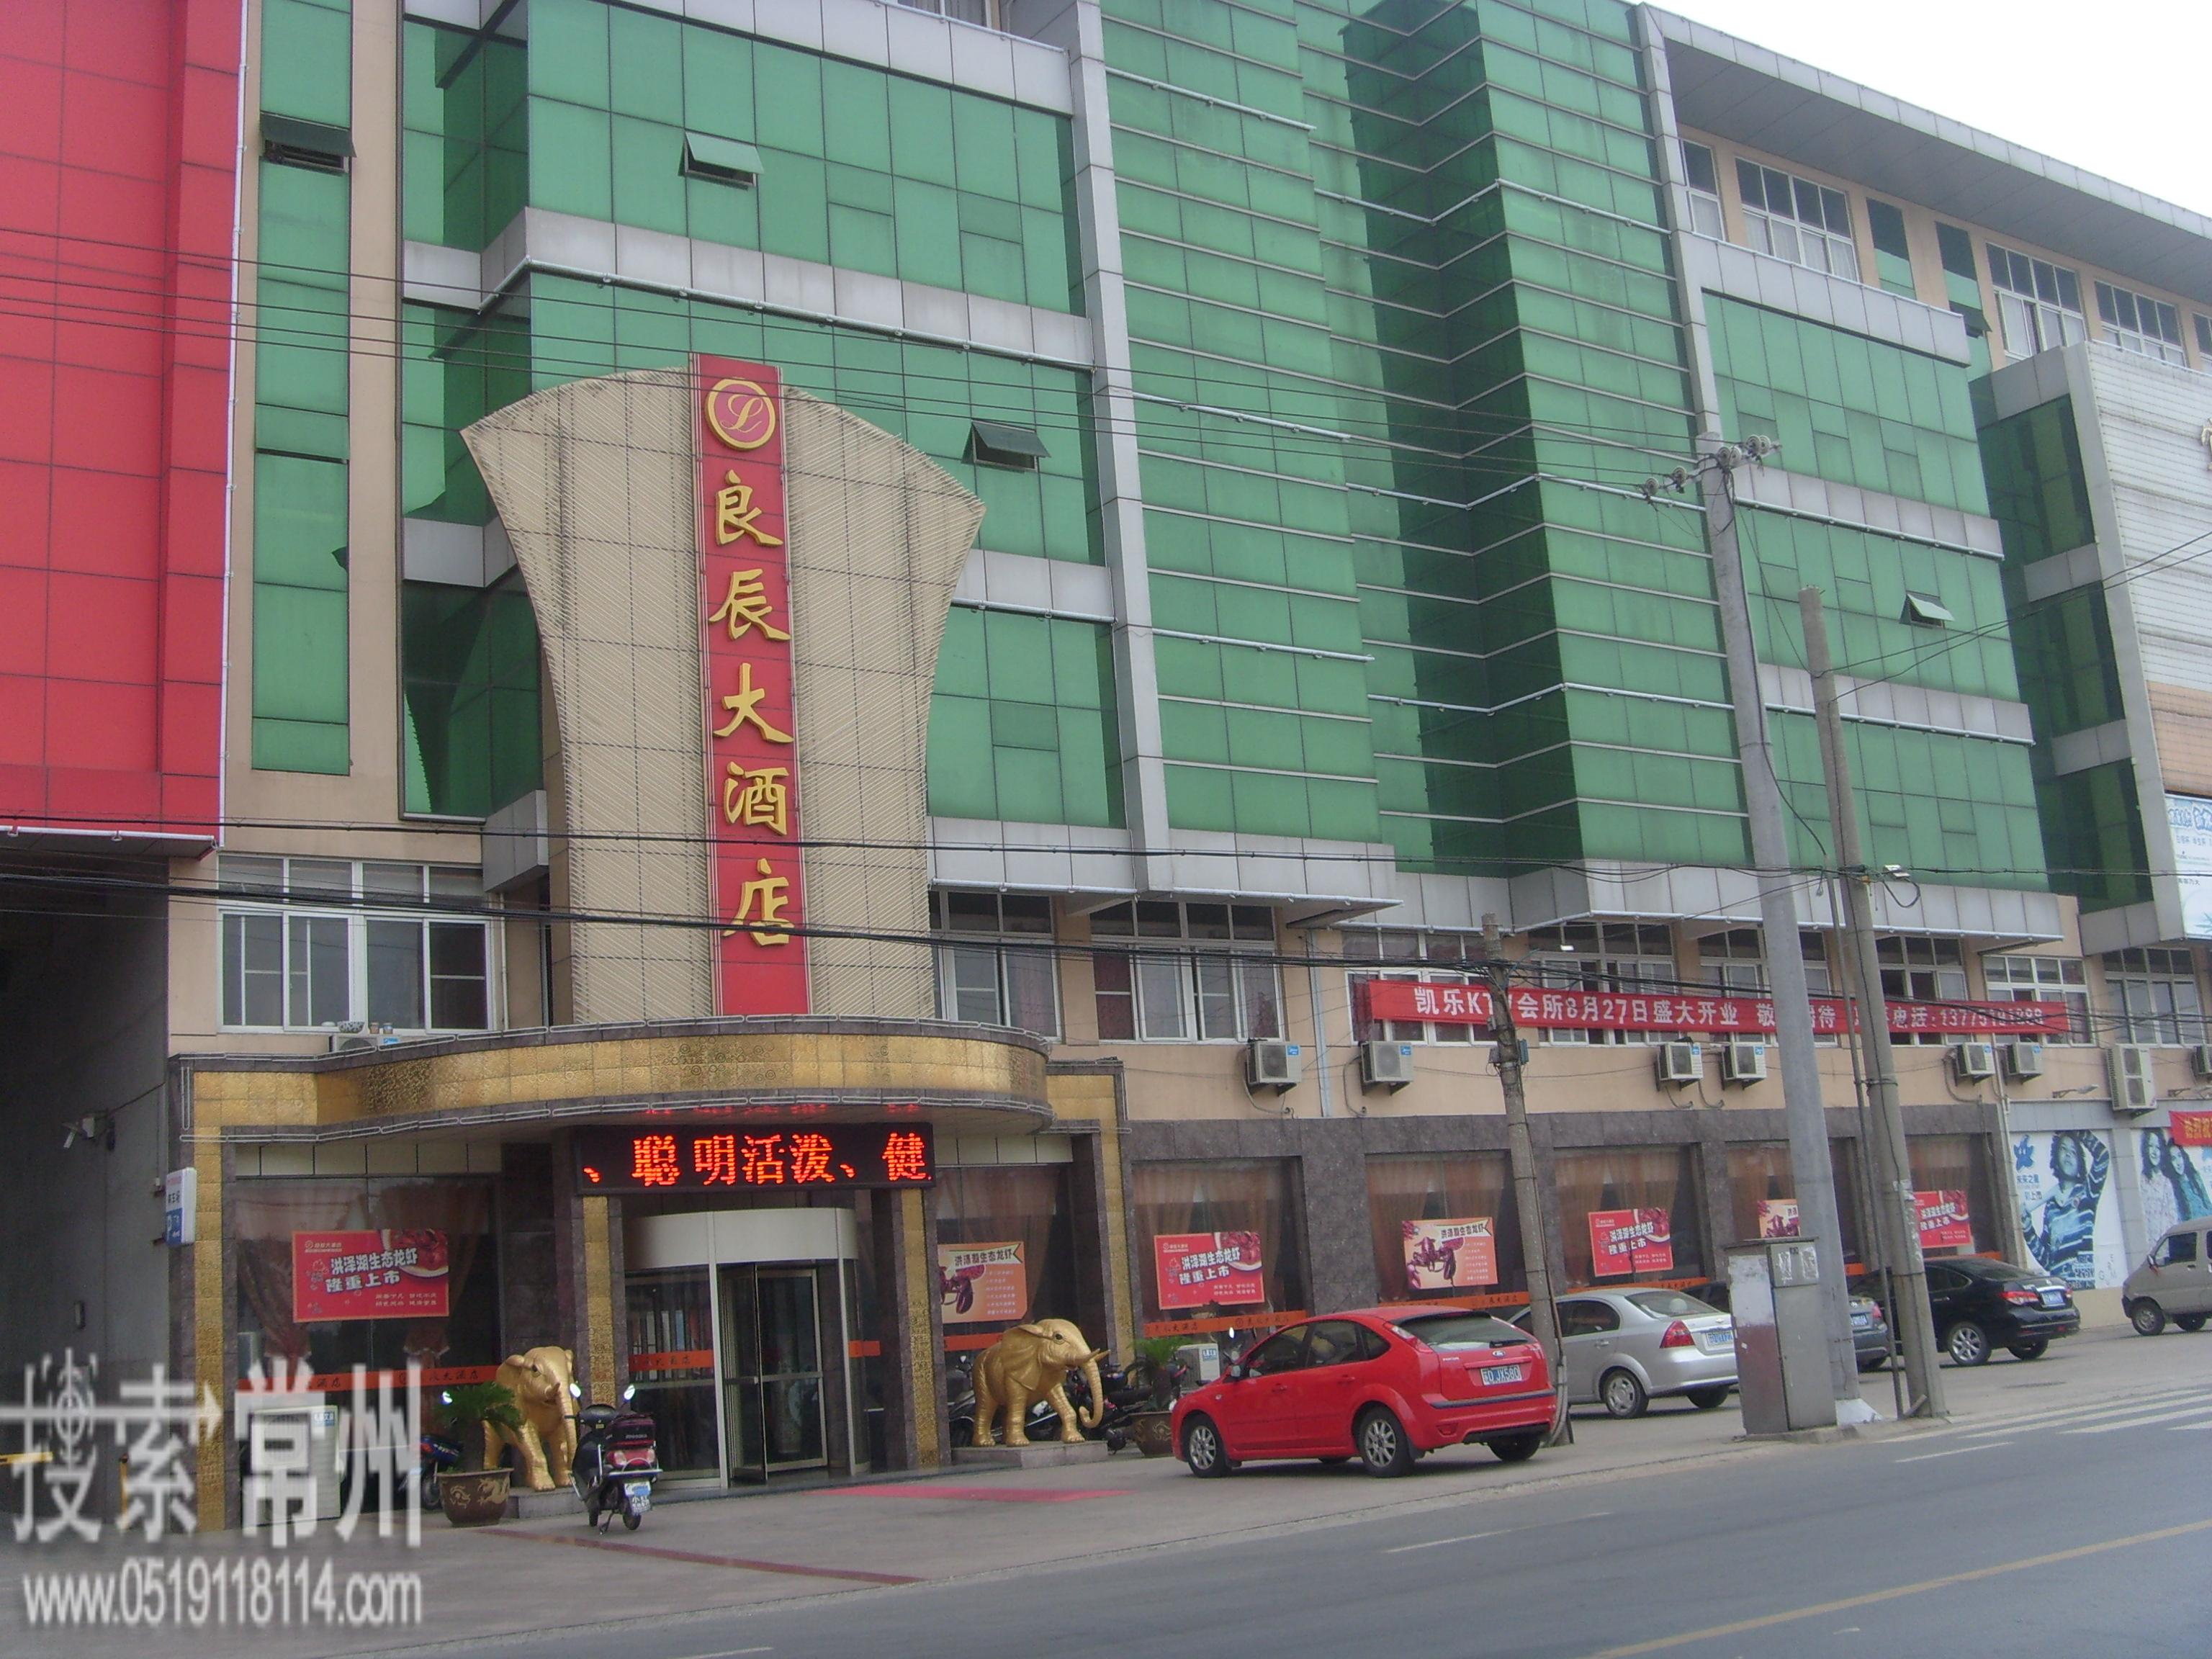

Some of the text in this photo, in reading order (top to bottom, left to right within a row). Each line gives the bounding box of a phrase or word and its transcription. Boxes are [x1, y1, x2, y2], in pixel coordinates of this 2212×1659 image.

[709, 469, 794, 946] 良辰大酒店
[1413, 986, 1740, 1025] 凯乐KT会所8月27日盛大开业
[330, 1248, 418, 1275] 洪泽湖生态龙虾
[1181, 1246, 1241, 1271] 洪泽湖生态龙虾
[325, 1269, 401, 1293] 隆重上市
[1179, 1265, 1230, 1285] 隆重上市
